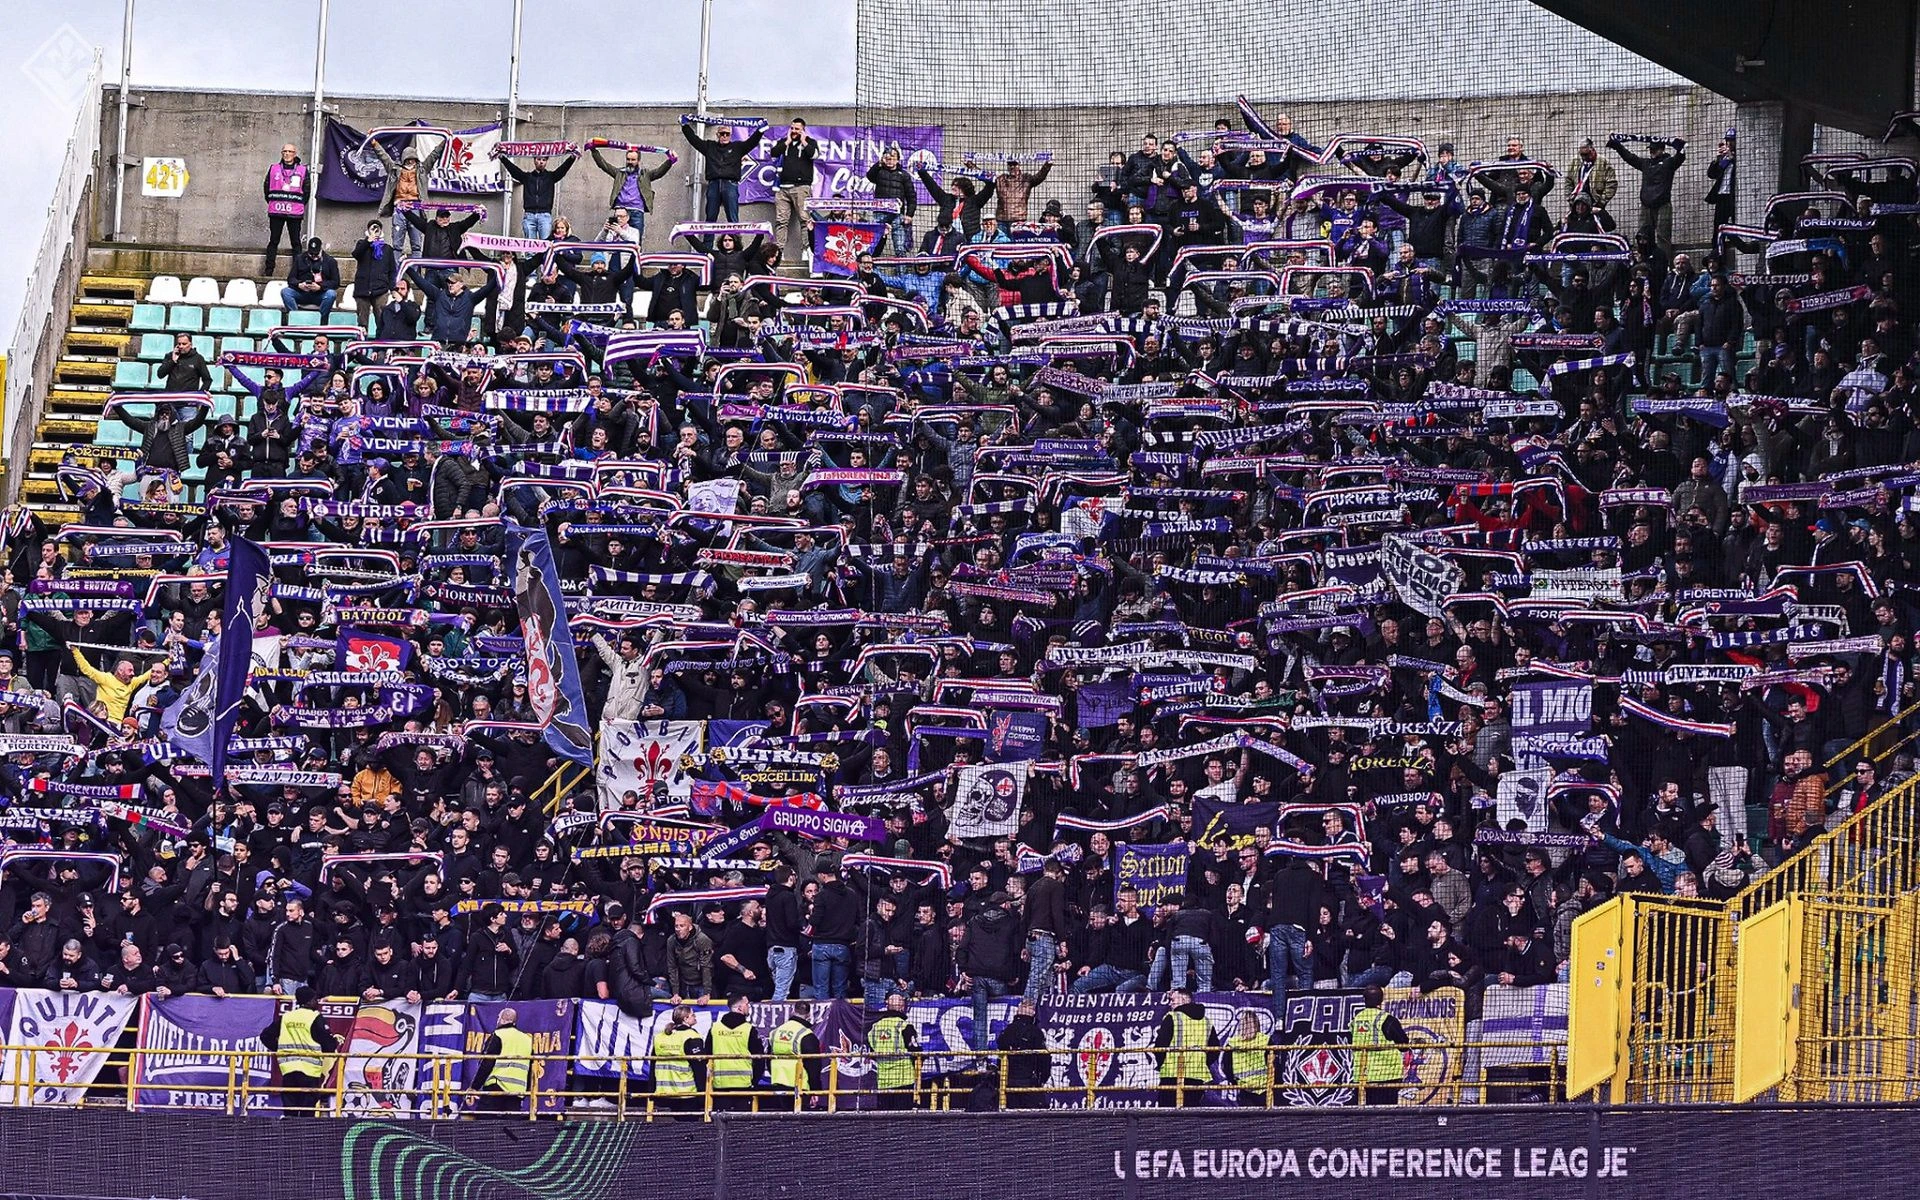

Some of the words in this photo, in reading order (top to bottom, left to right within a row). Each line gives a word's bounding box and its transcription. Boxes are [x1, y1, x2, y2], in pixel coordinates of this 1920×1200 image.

[759, 138, 903, 162] FENTINA
[147, 164, 180, 190] 421
[275, 202, 293, 213] 016
[1800, 217, 1863, 228] IORENTINA
[480, 236, 548, 254] FIORENTINA
[570, 303, 625, 313] MERDA
[236, 354, 309, 368] FIORENTINA
[370, 417, 419, 429] VCNP
[816, 432, 888, 441] FIORENTINA
[1409, 426, 1489, 435] FIORENNA
[362, 438, 408, 450] VCNP
[1145, 452, 1181, 464] ASTORI
[337, 502, 405, 517] ULTRAS
[1162, 519, 1203, 534] ULTRAS
[1204, 518, 1217, 531] 73
[94, 544, 163, 556] VIEUSSEUX
[714, 551, 782, 565] FIORENTINA
[1161, 564, 1239, 584] ULTRAS
[276, 585, 301, 598] LUPI
[438, 589, 511, 604] FIORENTINA
[1683, 588, 1754, 600] FIORENTINA
[79, 599, 138, 611] FIESOLE
[341, 610, 405, 622] BATIGOL
[1056, 647, 1097, 661] JUVE
[1176, 650, 1244, 665] FIORENTINA
[1669, 666, 1703, 679] JUVE
[1706, 666, 1753, 679] MERDA
[1151, 677, 1213, 699] COLLETTIVO
[1512, 690, 1535, 727] IL
[1540, 685, 1593, 725] MIO
[8, 742, 76, 754] FIORENTINA
[725, 746, 823, 766] ULTRAS
[287, 773, 318, 785] 1978
[47, 782, 119, 798] FIORENTINA
[773, 811, 820, 831] GRUPPO
[581, 842, 672, 858] MARASMA
[1040, 993, 1136, 1008] FIORENTINA
[1049, 1011, 1092, 1024] August
[145, 1009, 202, 1070] QUELLI
[209, 1038, 227, 1066] DI
[1193, 1148, 1301, 1179] EUROPA
[1308, 1147, 1502, 1179] CONFERENCE
